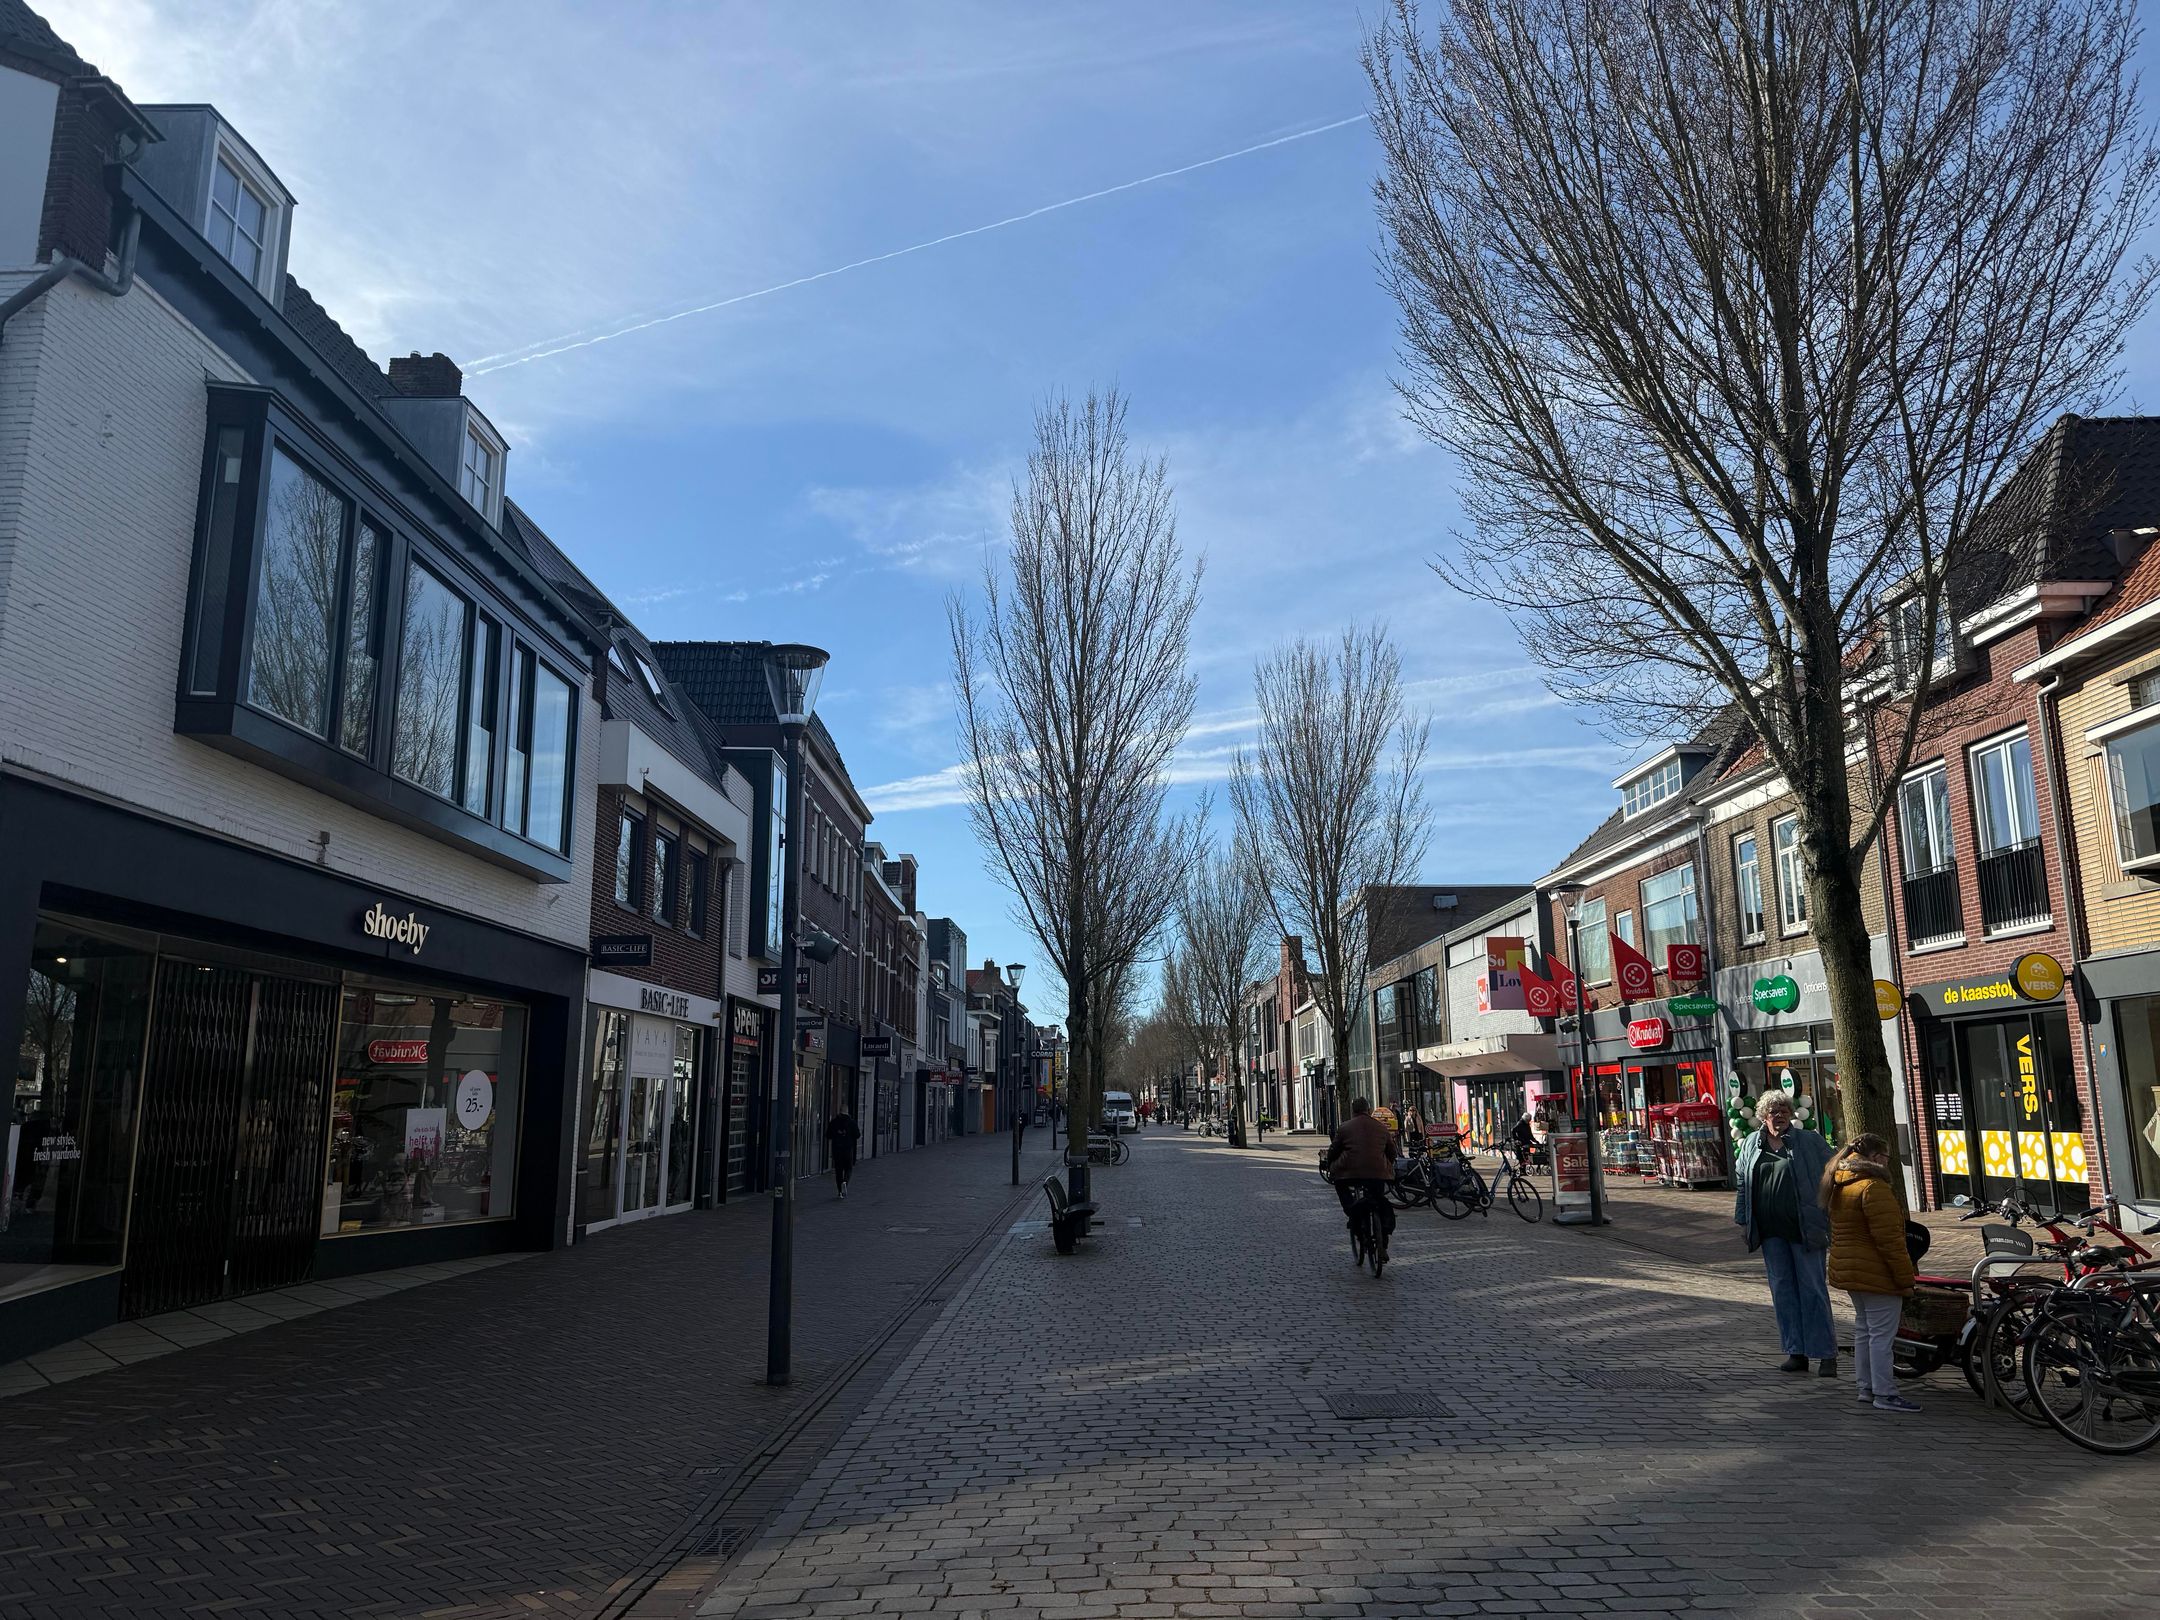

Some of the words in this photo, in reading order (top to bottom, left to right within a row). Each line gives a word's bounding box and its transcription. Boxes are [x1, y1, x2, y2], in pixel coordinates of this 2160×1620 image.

[364, 902, 430, 955] shoeby
[601, 944, 648, 953] BASIC-LIFE
[1488, 954, 1505, 967] So
[1803, 980, 1828, 996] Opticiens
[2024, 981, 2059, 991] VERS.
[1754, 987, 1788, 1002] Specsavers
[1943, 988, 1959, 1004] de
[640, 988, 690, 1018] BASIC-LIFE
[1876, 1003, 1898, 1011] ERS.
[636, 1027, 667, 1047] YAYA
[1636, 1024, 1661, 1041] Kruidvat
[2016, 1034, 2039, 1121] VERS.
[465, 1097, 483, 1113] 25.-
[42, 1136, 56, 1146] new
[57, 1131, 76, 1148] styles,
[33, 1147, 50, 1161] fresh
[51, 1146, 81, 1160] wardrobe
[1562, 1156, 1589, 1169] Sale
